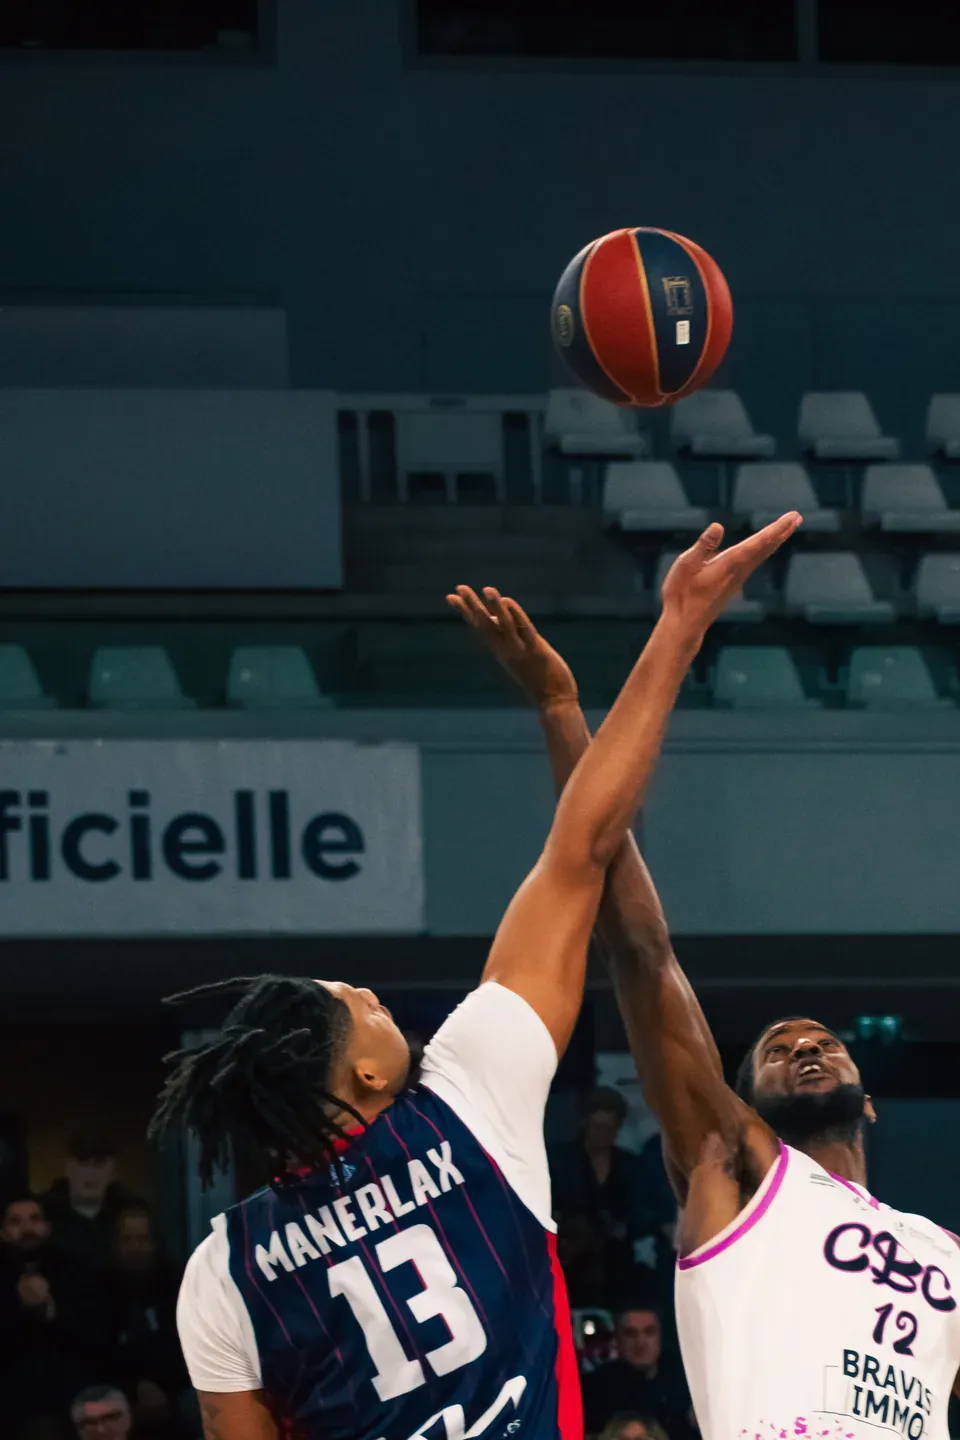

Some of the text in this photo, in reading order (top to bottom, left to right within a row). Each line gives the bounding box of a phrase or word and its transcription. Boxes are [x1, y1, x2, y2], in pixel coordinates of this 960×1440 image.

[255, 1140, 465, 1282] MANERLAX
[327, 1223, 488, 1402] 13
[872, 1302, 915, 1357] 12
[843, 1349, 934, 1416] BRAVIS
